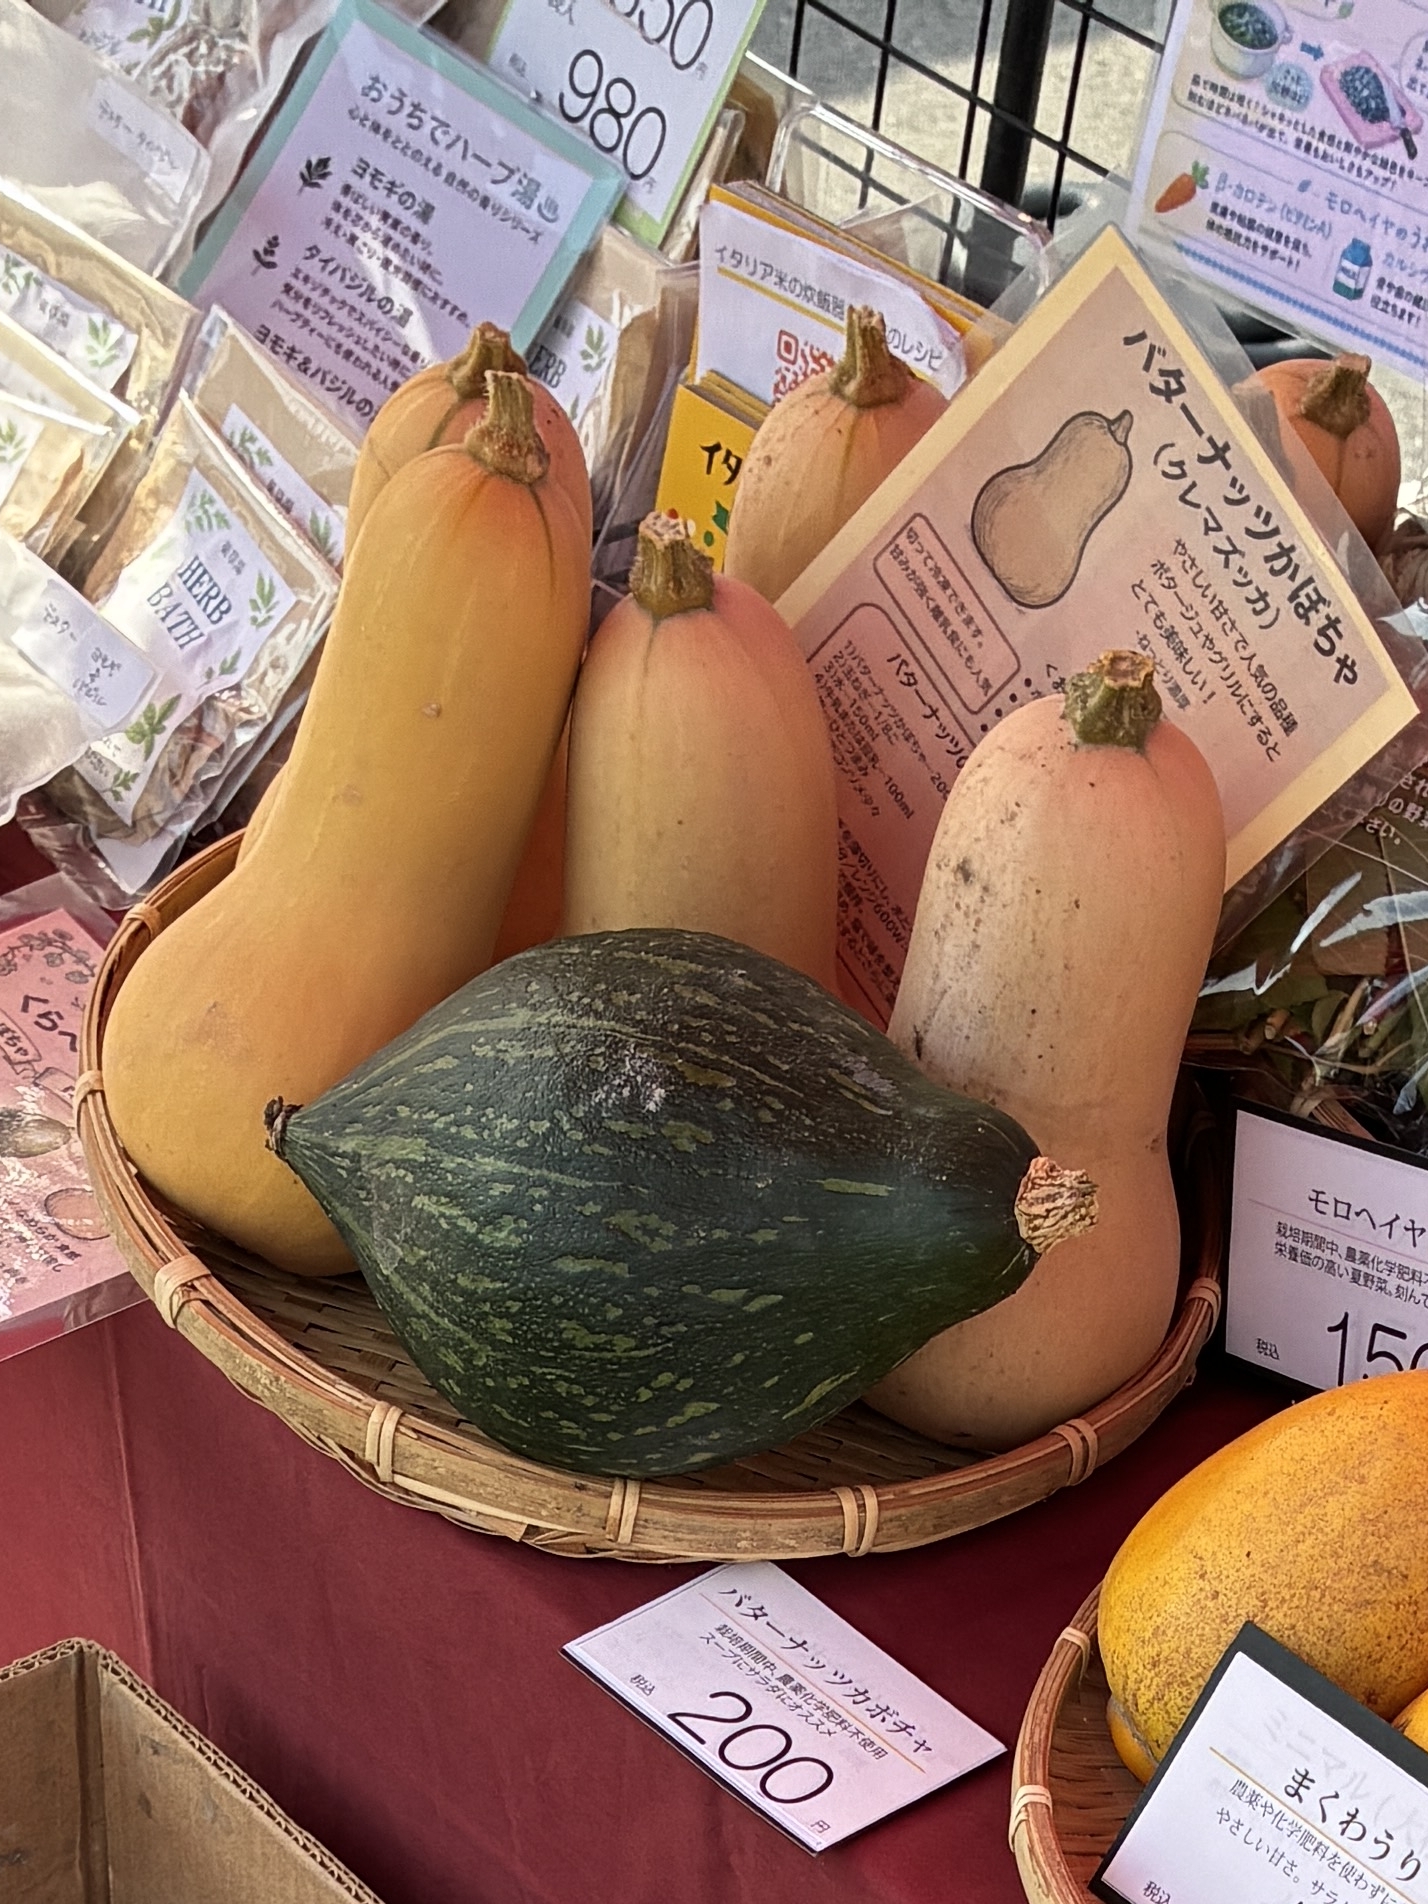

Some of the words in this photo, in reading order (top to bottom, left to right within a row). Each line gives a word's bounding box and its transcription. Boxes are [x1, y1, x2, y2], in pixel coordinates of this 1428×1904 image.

[361, 73, 542, 211] おうちでハーブ湯
[559, 49, 667, 180] 980
[351, 157, 435, 225] ヨモギの湯
[303, 244, 414, 328] タイバジルの湯
[252, 324, 383, 423] ヨモギ&バジルの
[528, 343, 568, 390] ERB
[1123, 329, 1359, 686] バターナッツかぼちゃ
[1153, 442, 1281, 631] （クレマズッカ）
[146, 583, 207, 652] BATH
[179, 553, 233, 627] HERB
[1171, 538, 1298, 740] やさしい甘さで人気の品種
[1149, 557, 1282, 764] ポタージュやグリルにすると
[1308, 1188, 1427, 1248] モロヘイヤ
[1255, 1337, 1280, 1360] 税込
[630, 1674, 658, 1697] 税込
[699, 1634, 838, 1738] スープにサラダにオススメ
[714, 1623, 889, 1760] 栽培期間中、農薬化学肥料不使用
[718, 1586, 934, 1756] バターナッツカボチャ
[666, 1690, 835, 1804] 200
[811, 1820, 831, 1834] 円
[1283, 1767, 1422, 1883] まくわうり
